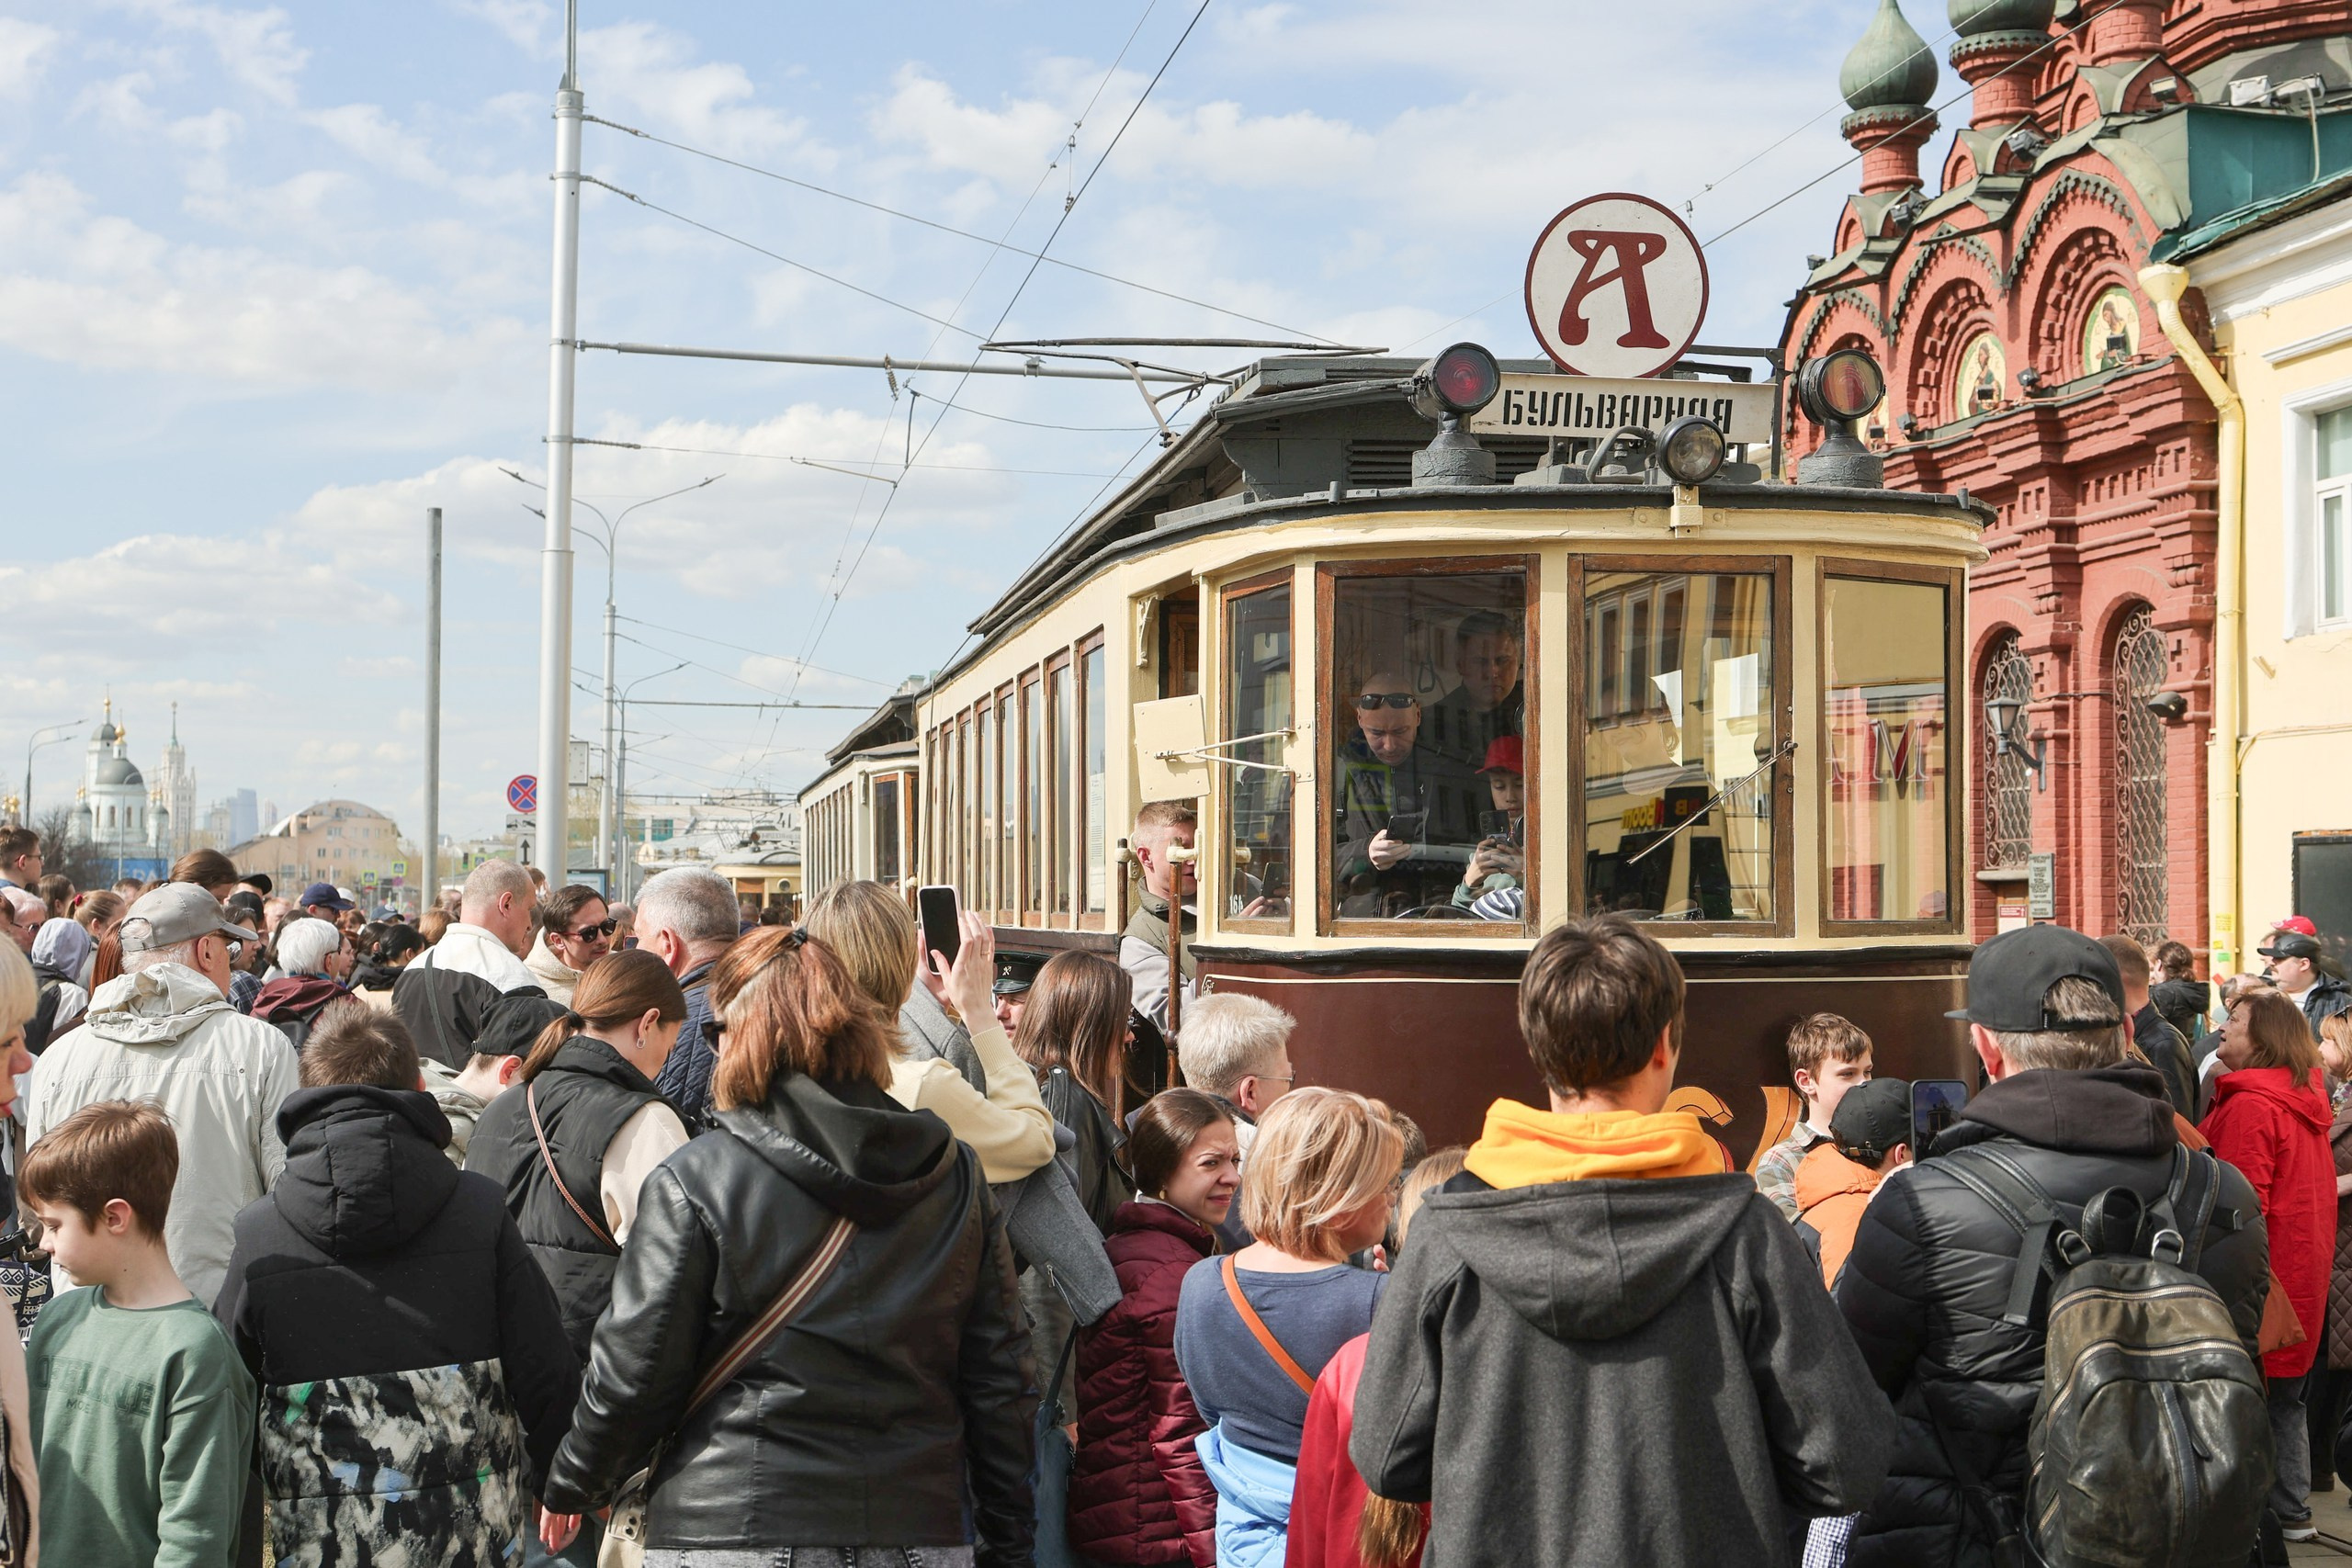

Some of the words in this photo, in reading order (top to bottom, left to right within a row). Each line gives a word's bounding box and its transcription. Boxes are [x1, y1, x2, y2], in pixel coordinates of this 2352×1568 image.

[1558, 230, 1670, 349] А
[1502, 389, 1734, 434] БУЛЬВАРНАЯ
[776, 812, 792, 829] 41
